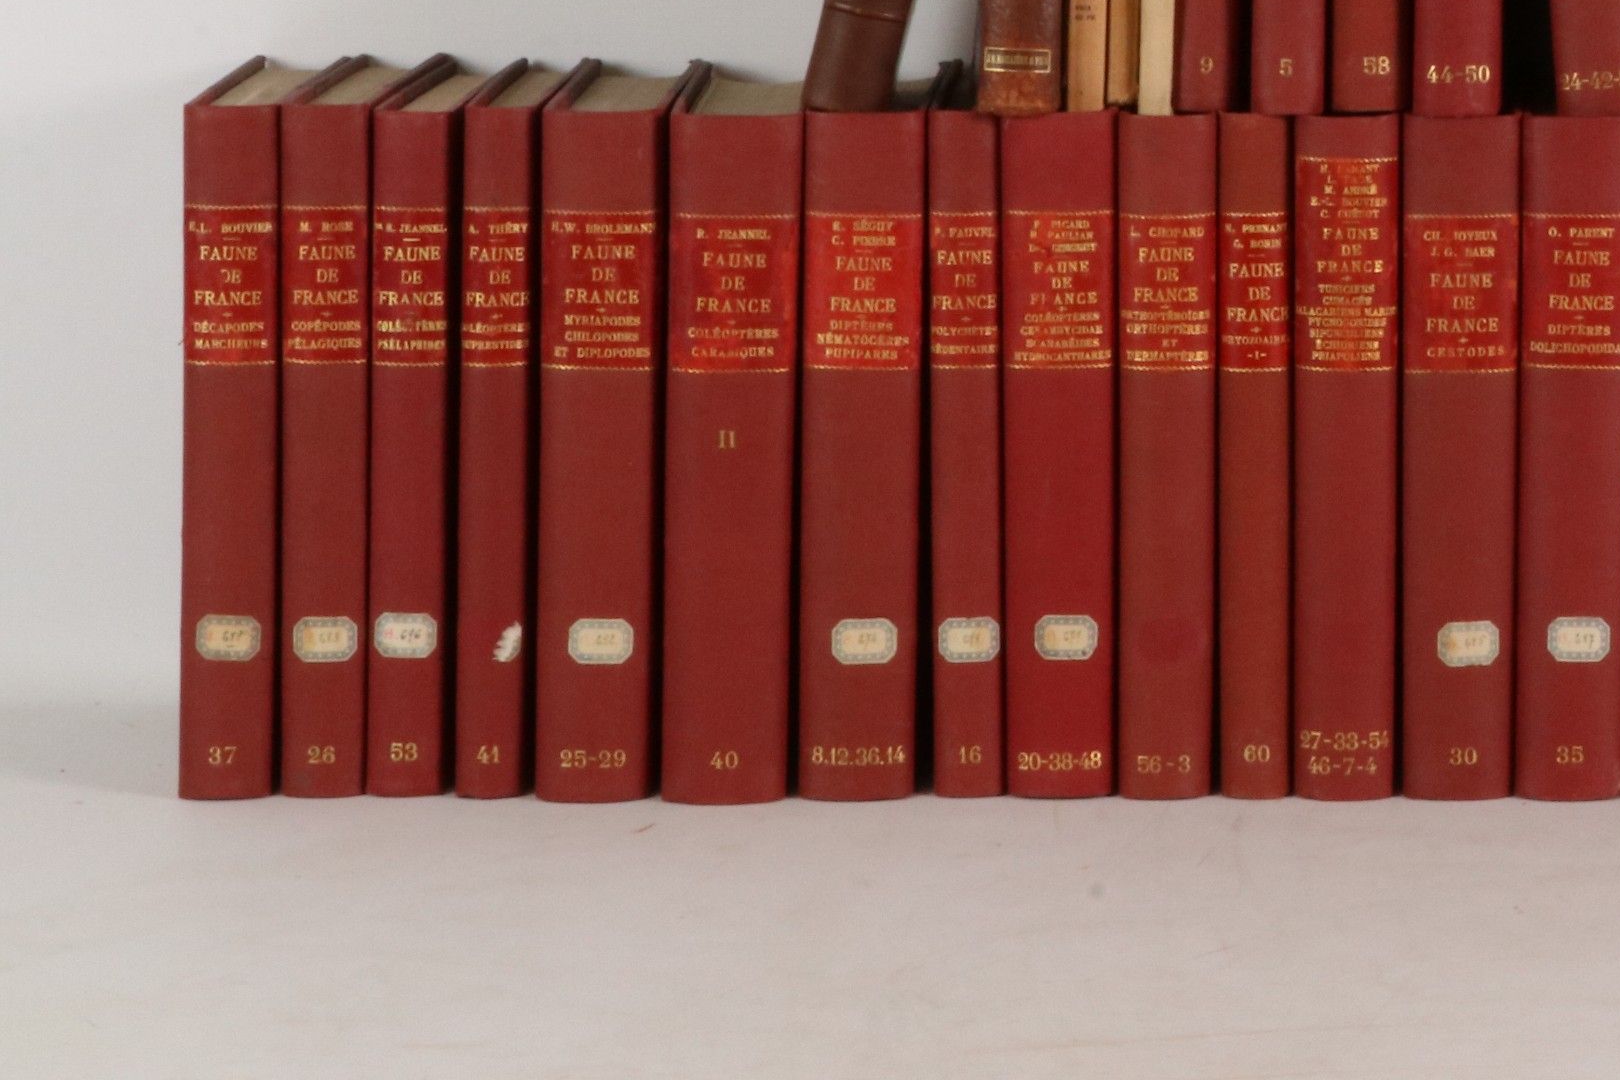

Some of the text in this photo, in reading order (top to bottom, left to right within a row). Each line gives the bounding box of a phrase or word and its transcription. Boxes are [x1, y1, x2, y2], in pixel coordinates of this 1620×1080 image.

[1200, 57, 1213, 73] 9
[1279, 58, 1292, 75] 5
[1364, 56, 1390, 75] 58
[1427, 65, 1490, 83] 44-50
[200, 245, 256, 261] FAUNE
[299, 245, 355, 260] FAUNE
[572, 245, 635, 259] FAUNE
[1554, 250, 1610, 266] FAUNE
[317, 268, 338, 282] DE
[592, 267, 615, 281] DE
[1431, 273, 1492, 288] FAUNE
[1569, 273, 1591, 287] DE
[195, 290, 261, 306] FRANCE
[293, 289, 358, 305] FRANCE
[565, 288, 639, 304] FRANCE
[1453, 296, 1475, 309] DE
[1549, 294, 1614, 310] FRANCE
[1427, 317, 1498, 332] FRANCE
[1301, 731, 1388, 750] 27-33-54
[208, 746, 236, 765] 37
[307, 746, 335, 764] 26
[390, 742, 418, 761] 53
[477, 746, 499, 764] 41
[560, 749, 626, 768] 25-29
[710, 751, 738, 769] 40
[812, 746, 905, 765] 8.12.36.14
[959, 745, 981, 763] 16
[1244, 745, 1270, 762] 60
[1450, 748, 1478, 765] 30
[1556, 746, 1584, 764] 35
[1019, 751, 1102, 770] 20-38-48
[1137, 755, 1191, 773] 56-3
[1308, 756, 1377, 775] 46-7-4
